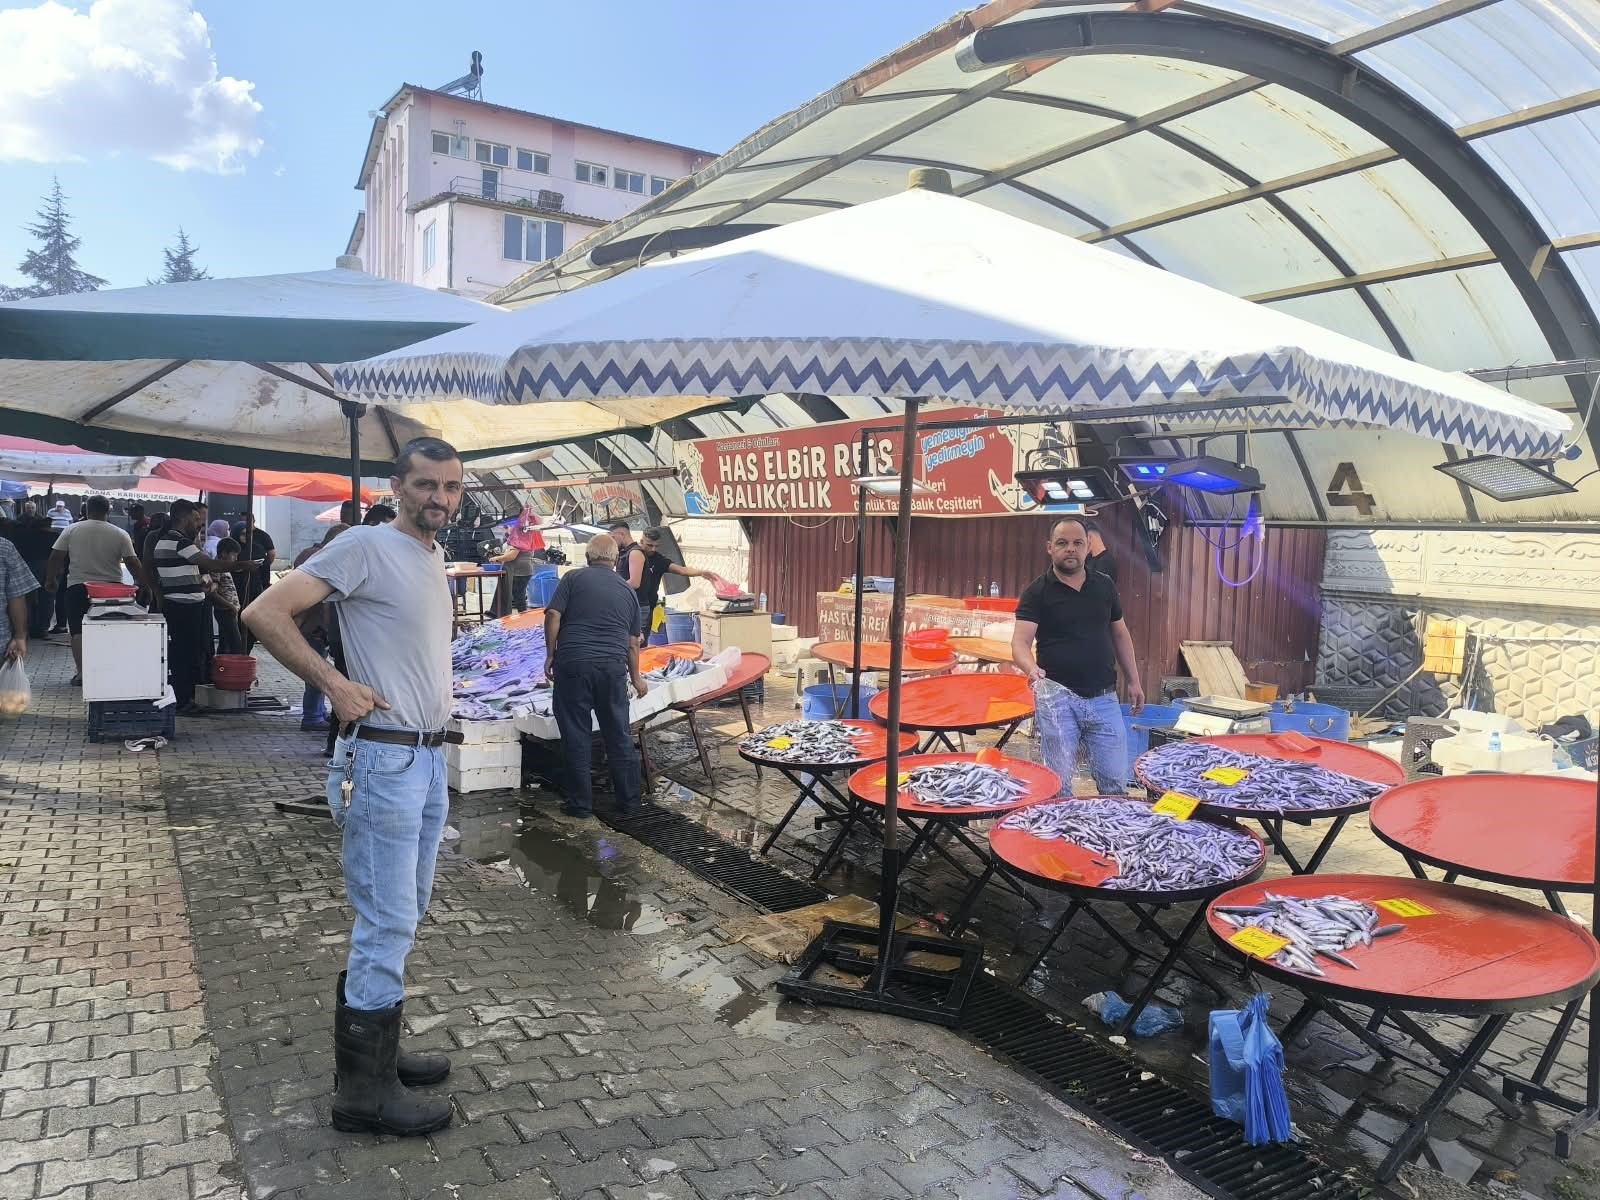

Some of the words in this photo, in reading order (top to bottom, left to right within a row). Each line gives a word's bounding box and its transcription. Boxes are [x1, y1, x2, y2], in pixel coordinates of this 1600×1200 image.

[718, 453, 759, 482] HAS
[84, 489, 111, 497] ADANA
[722, 480, 832, 513] BALIKÇILIK
[1326, 462, 1376, 515] 4
[853, 498, 886, 513] Gnlük
[910, 496, 935, 511] Balık
[936, 495, 983, 513] Çeşitleri
[819, 610, 840, 624] HAS
